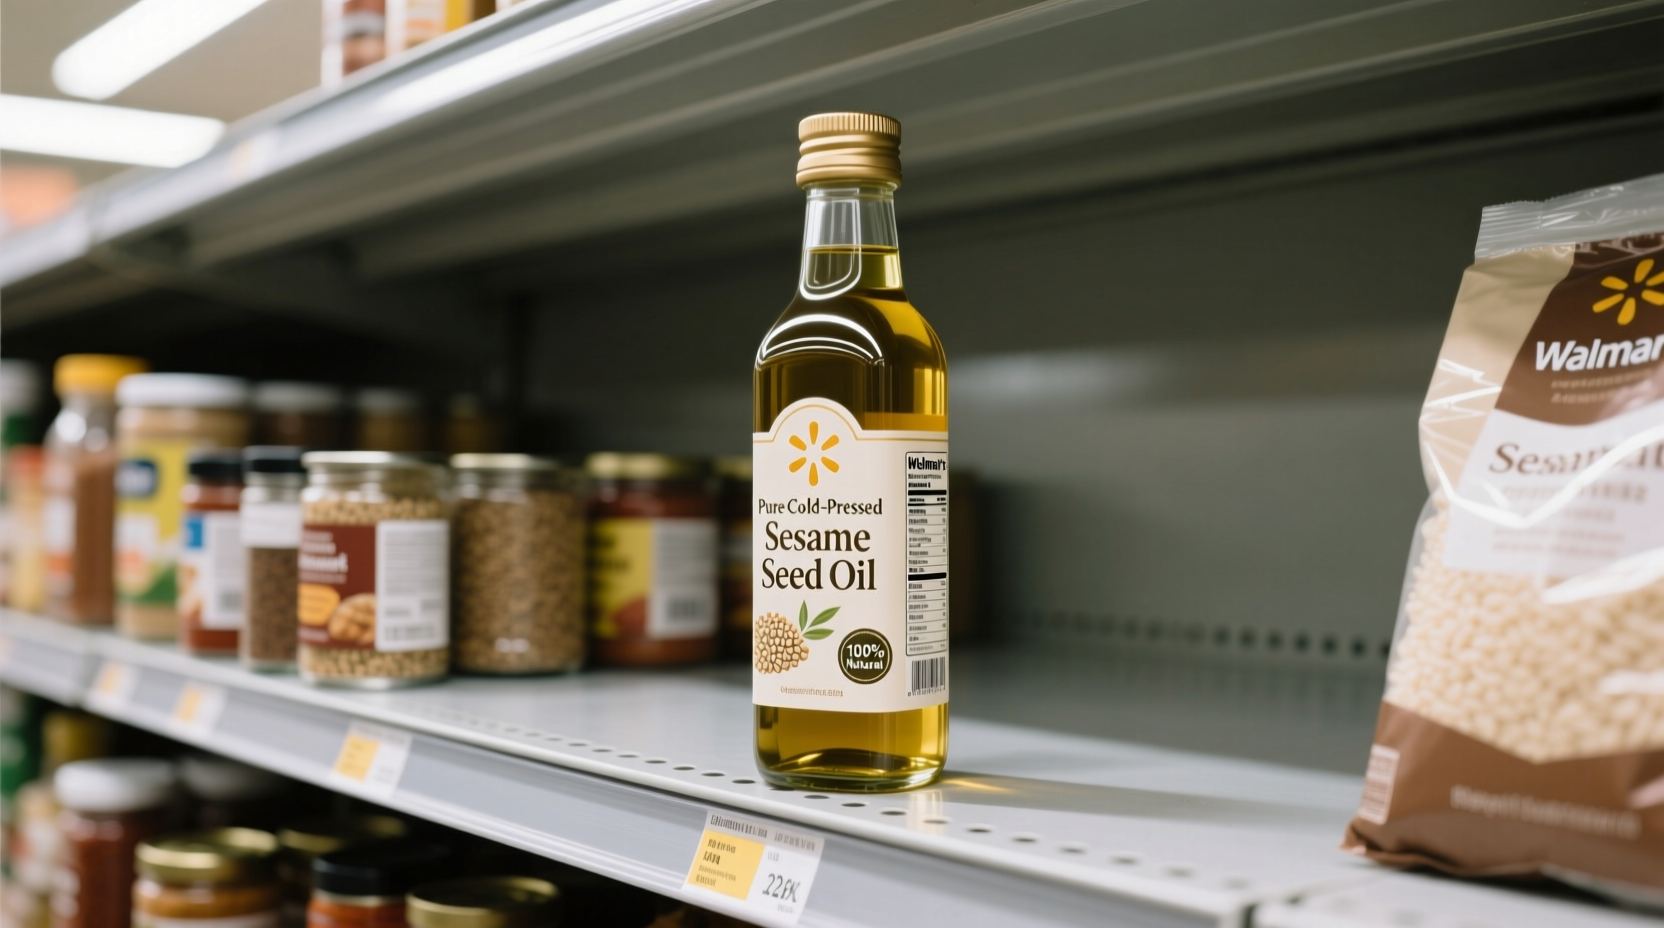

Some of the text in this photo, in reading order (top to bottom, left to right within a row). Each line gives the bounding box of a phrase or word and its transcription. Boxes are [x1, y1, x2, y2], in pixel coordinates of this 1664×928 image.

[758, 497, 883, 515] Pure Cold-Pressed
[765, 520, 871, 552] Sesame
[761, 558, 877, 591] Seed Oil
[846, 643, 885, 658] 100%
